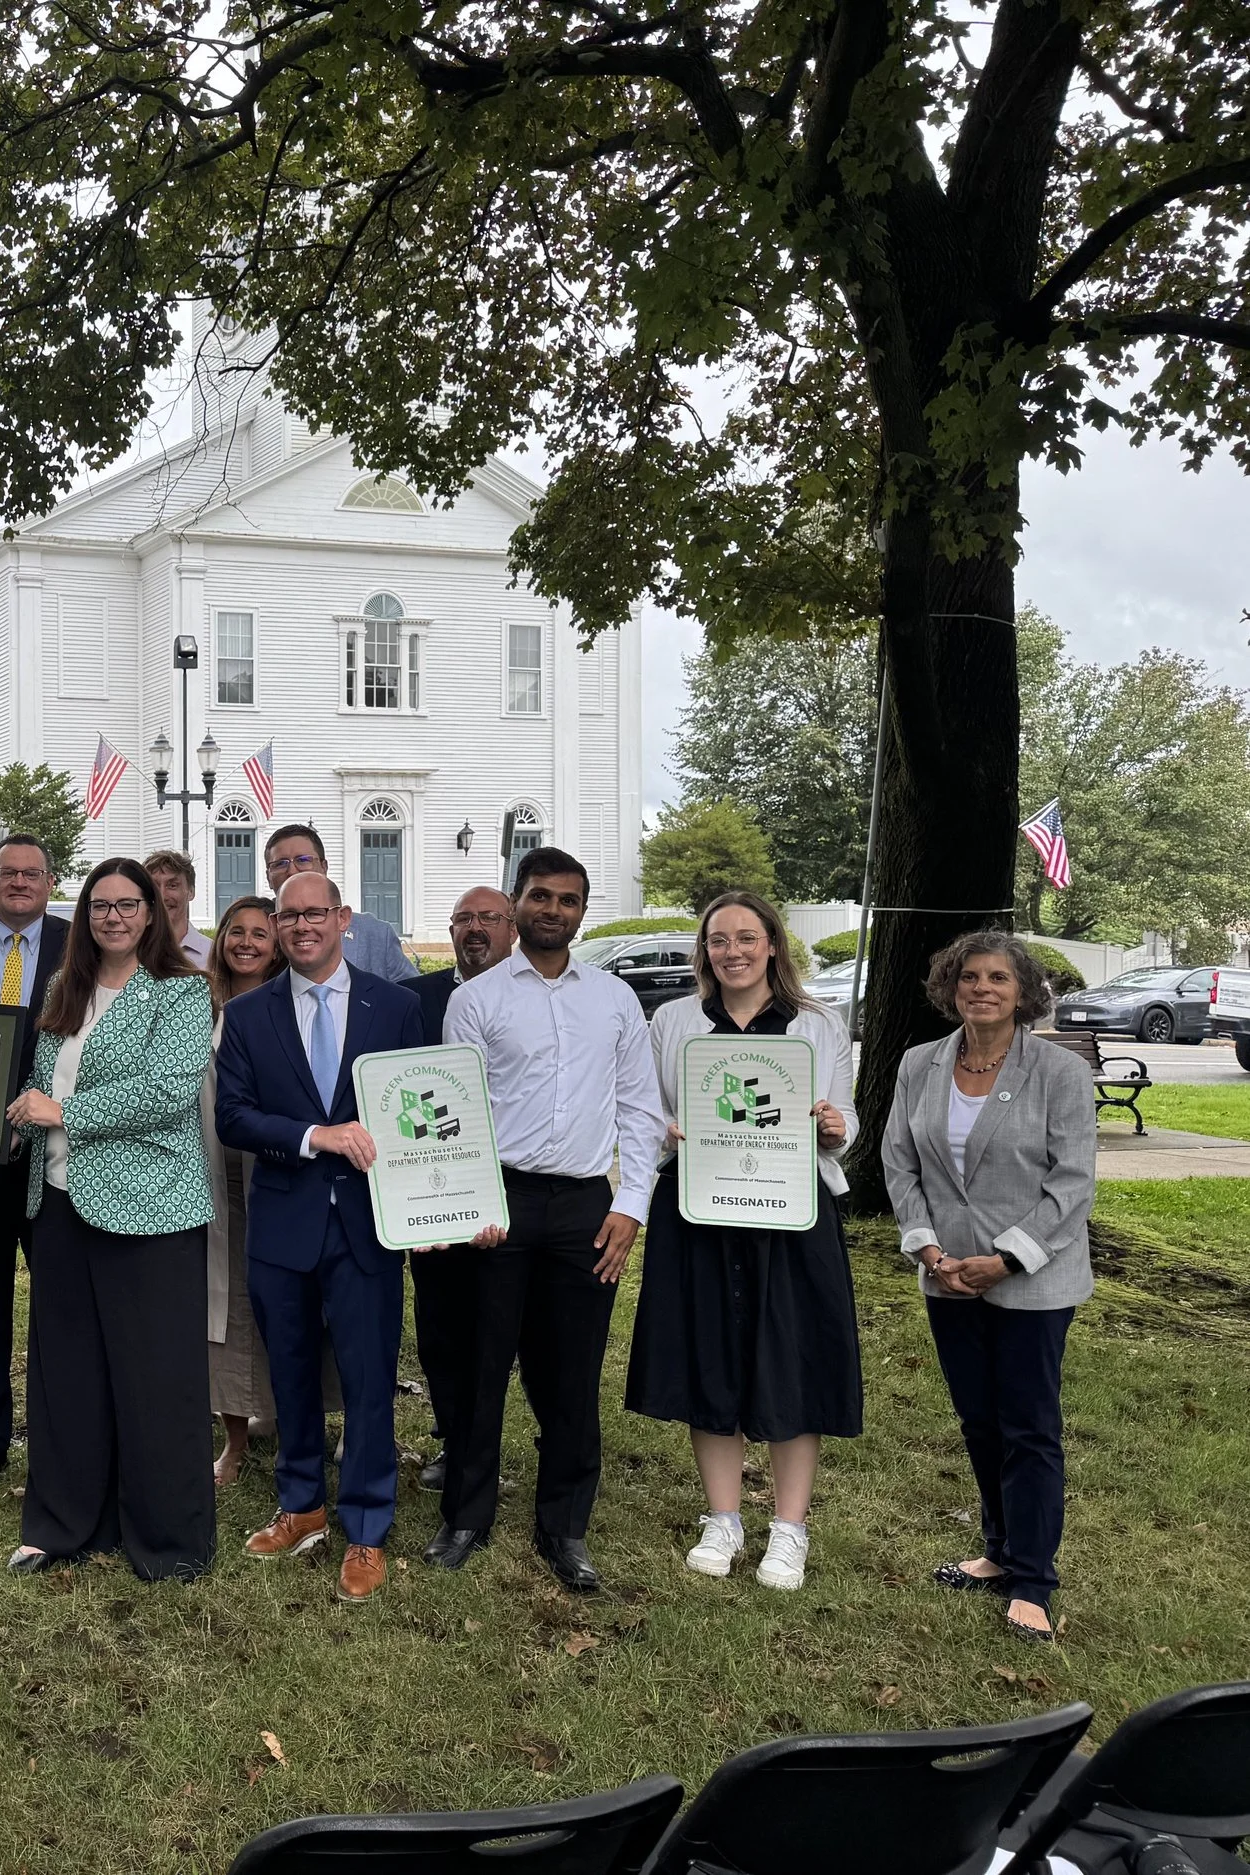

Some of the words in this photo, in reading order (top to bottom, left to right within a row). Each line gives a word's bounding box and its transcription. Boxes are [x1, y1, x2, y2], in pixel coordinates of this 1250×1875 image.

[701, 1058, 728, 1092] GREEN
[731, 1052, 796, 1094] COMMUNITY
[380, 1074, 403, 1112] GREEN
[404, 1066, 470, 1102] COMMUNITY
[404, 1146, 462, 1157] Massachusetts
[700, 1138, 734, 1147] DEPARTMENT
[745, 1140, 765, 1148] ENERGY
[767, 1141, 798, 1150] RESOURCES
[388, 1156, 421, 1168] DEPARTMENT
[422, 1155, 430, 1164] OF
[430, 1154, 450, 1162] ENERGY
[452, 1150, 480, 1160] RESOURCES
[712, 1196, 788, 1208] DESIGNATED
[408, 1210, 479, 1226] DESIGNATED
